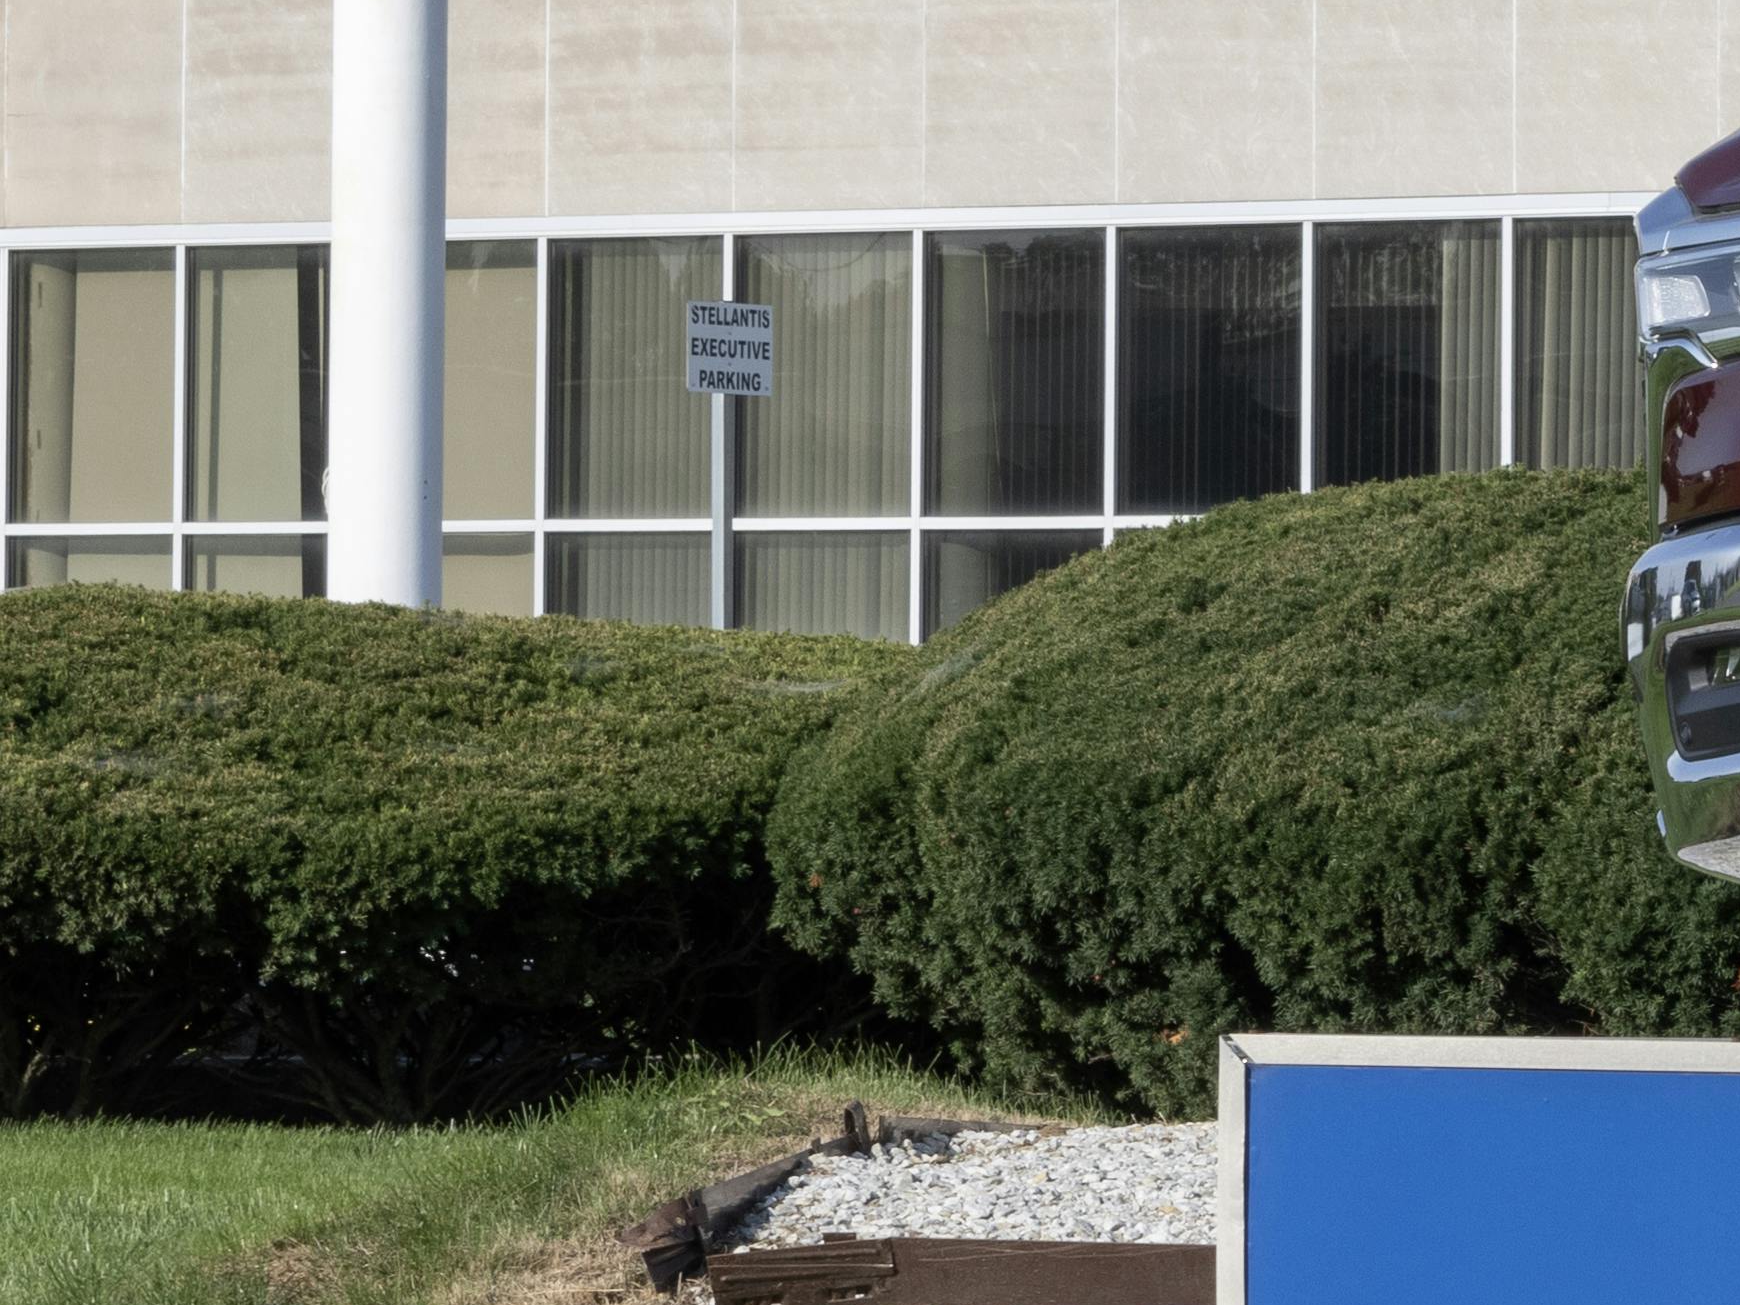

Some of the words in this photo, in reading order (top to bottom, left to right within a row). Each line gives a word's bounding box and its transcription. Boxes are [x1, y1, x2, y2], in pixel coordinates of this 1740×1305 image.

[691, 305, 770, 329] STELLANTIS
[691, 337, 770, 360] EXECUTIVE
[699, 369, 761, 392] PARKING
